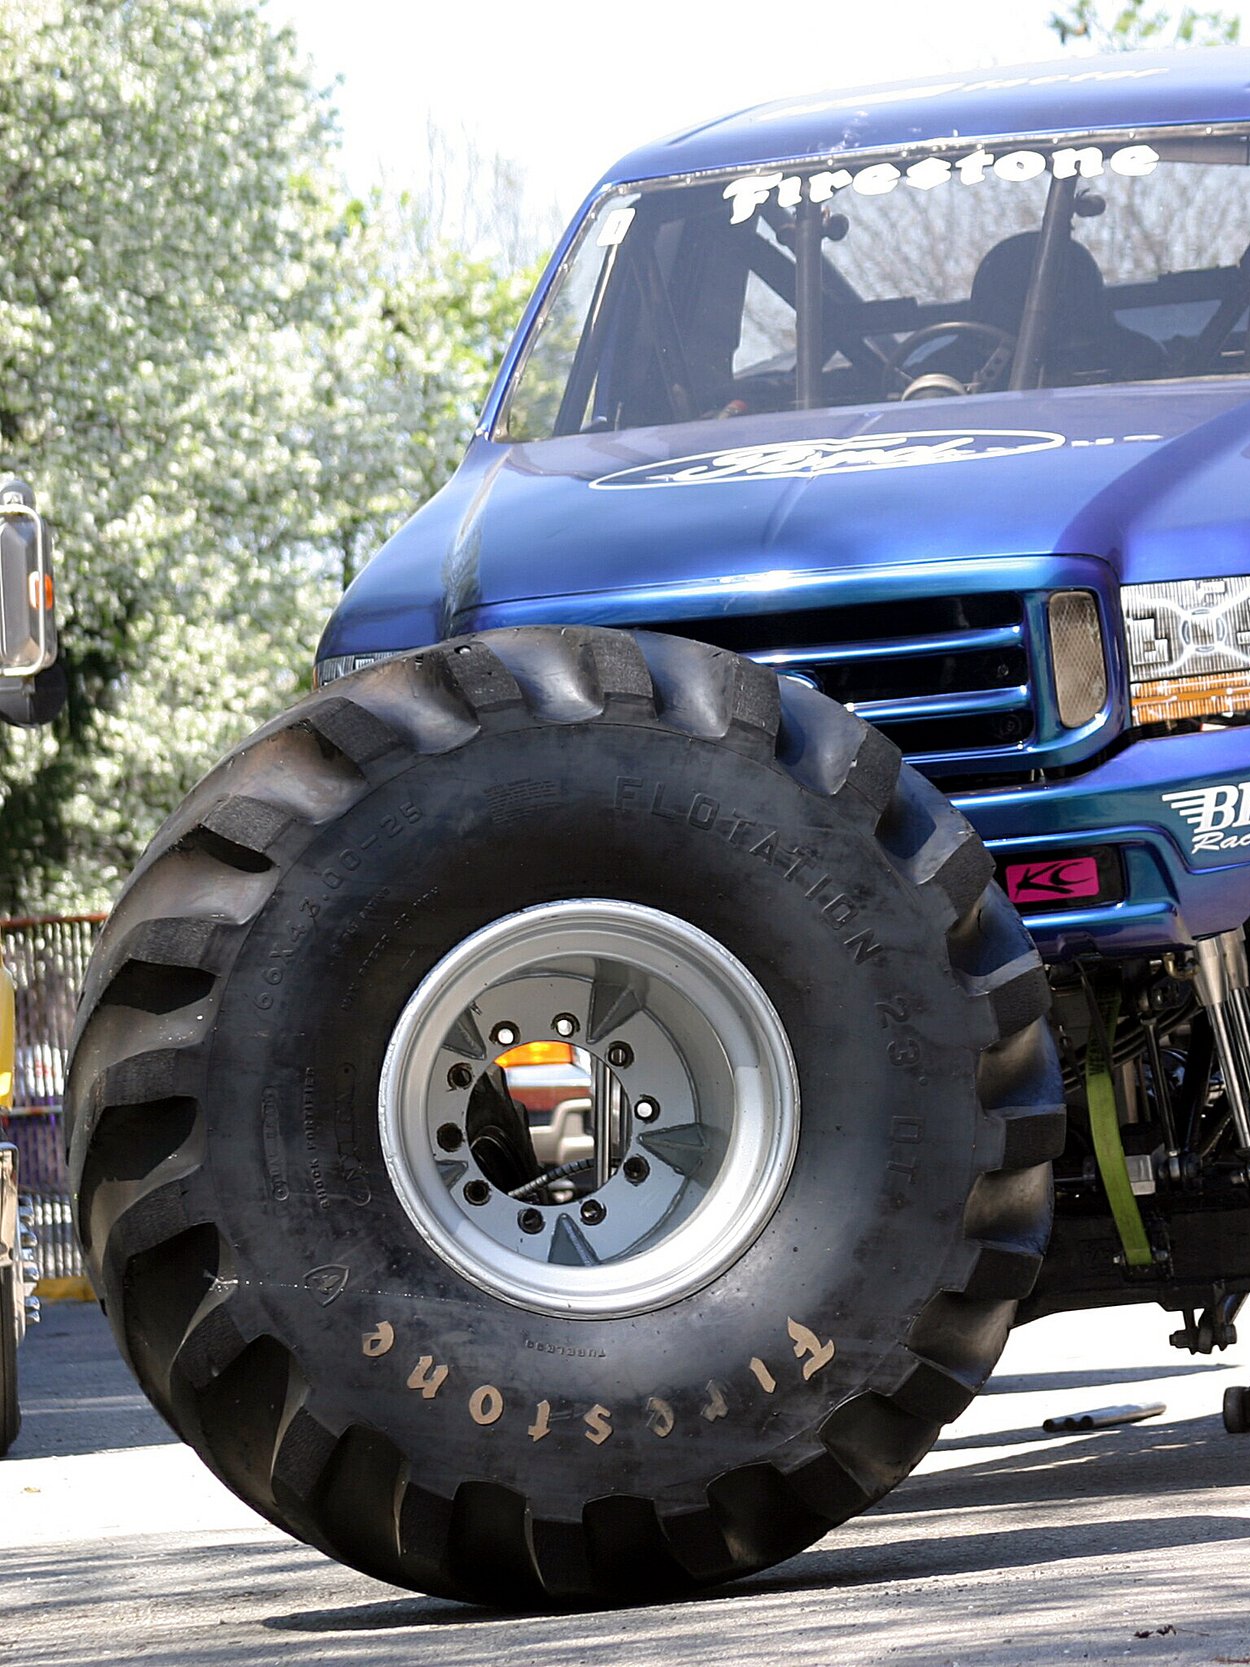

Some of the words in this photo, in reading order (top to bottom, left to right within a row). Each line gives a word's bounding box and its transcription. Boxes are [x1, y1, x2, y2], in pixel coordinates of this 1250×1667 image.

[723, 142, 1161, 225] Firestone
[614, 775, 883, 966] FLOTATION
[1016, 861, 1096, 896] KC
[361, 1315, 835, 1445] Firestone
